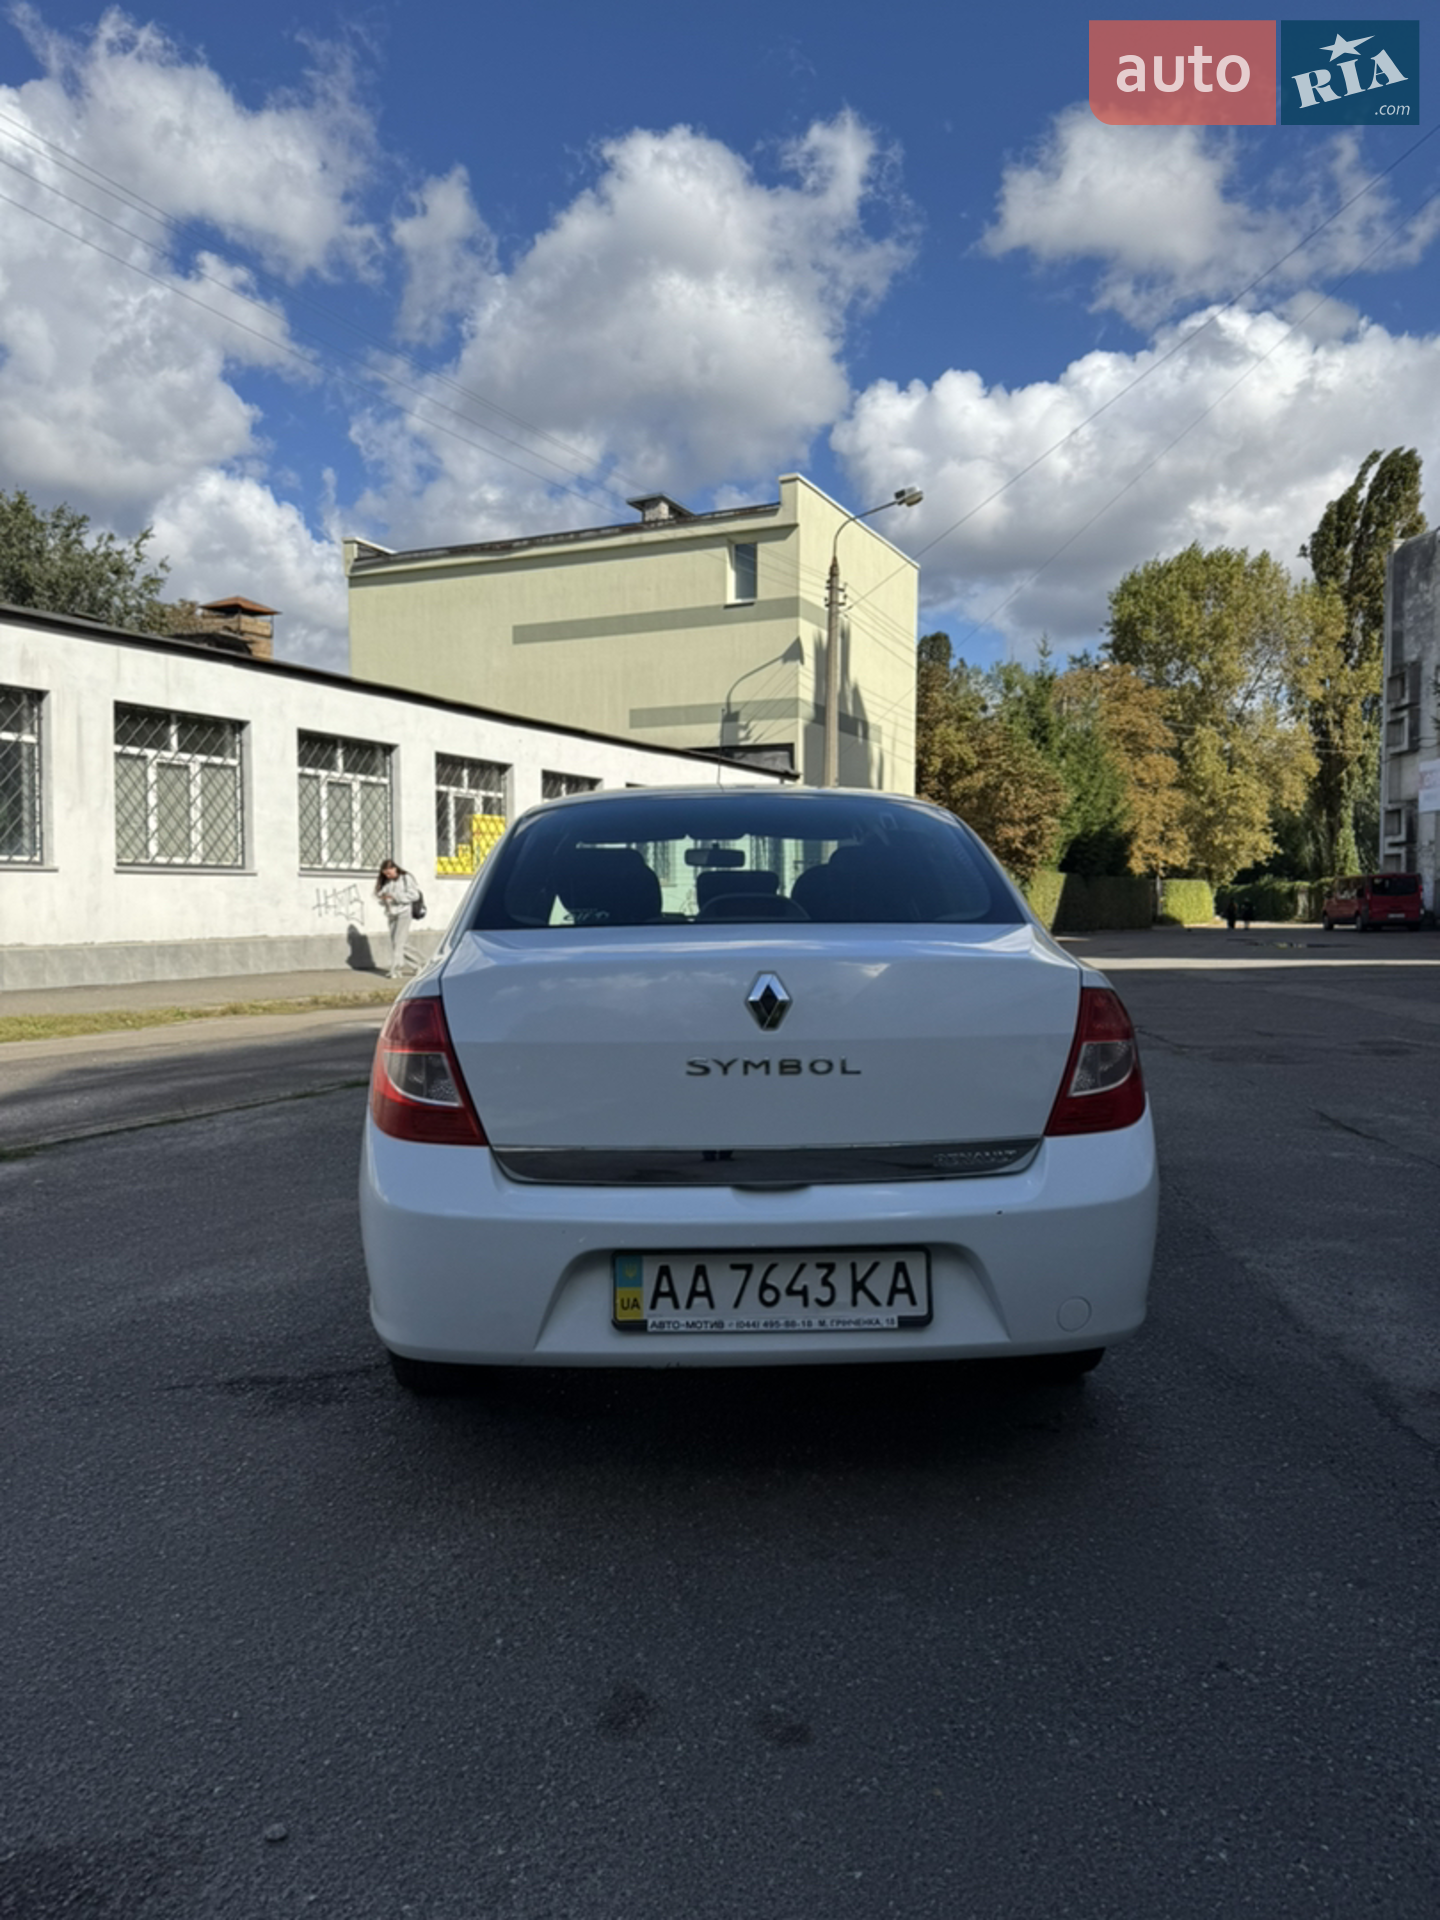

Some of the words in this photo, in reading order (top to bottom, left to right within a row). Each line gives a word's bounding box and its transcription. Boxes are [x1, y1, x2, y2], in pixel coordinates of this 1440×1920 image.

[685, 1058, 863, 1077] SYMBOL
[933, 1150, 1018, 1167] RENAULT
[649, 1264, 715, 1310] AA
[729, 1261, 837, 1309] 7643
[850, 1261, 918, 1307] KA
[620, 1297, 641, 1311] UA
[649, 1319, 725, 1331] АВТО-МОТИВ
